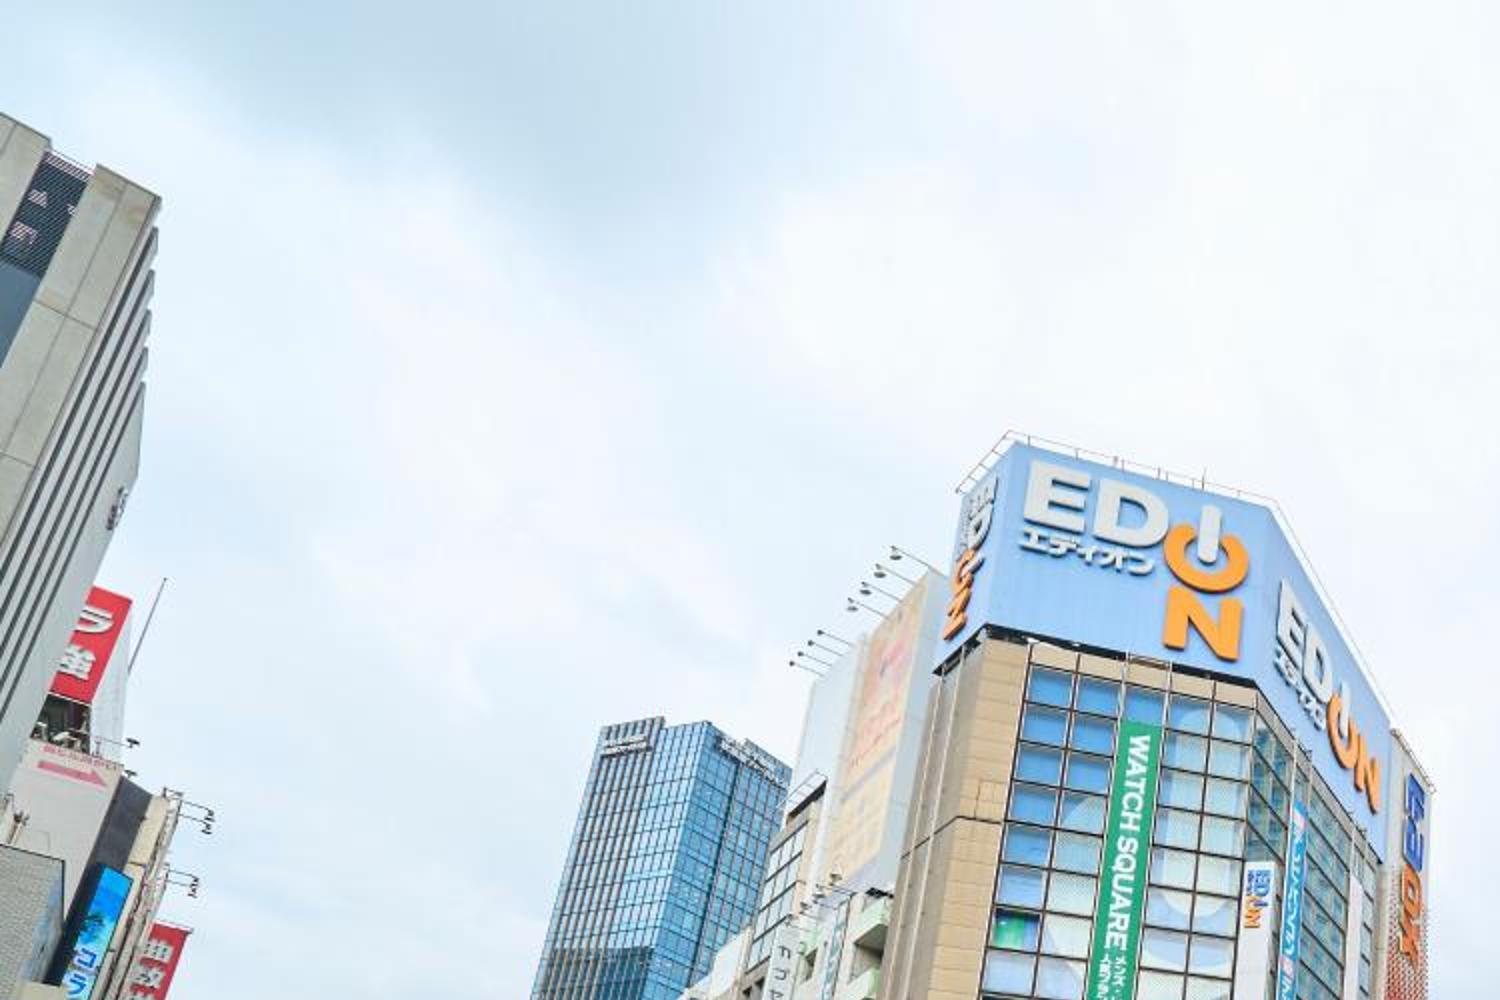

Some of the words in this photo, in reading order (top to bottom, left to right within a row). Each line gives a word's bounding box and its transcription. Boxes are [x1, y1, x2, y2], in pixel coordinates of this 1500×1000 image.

[1019, 523, 1157, 576] エディオン
[1022, 459, 1250, 662] EDION
[1120, 734, 1152, 829] WATCH
[1104, 834, 1139, 951] SQUARE
